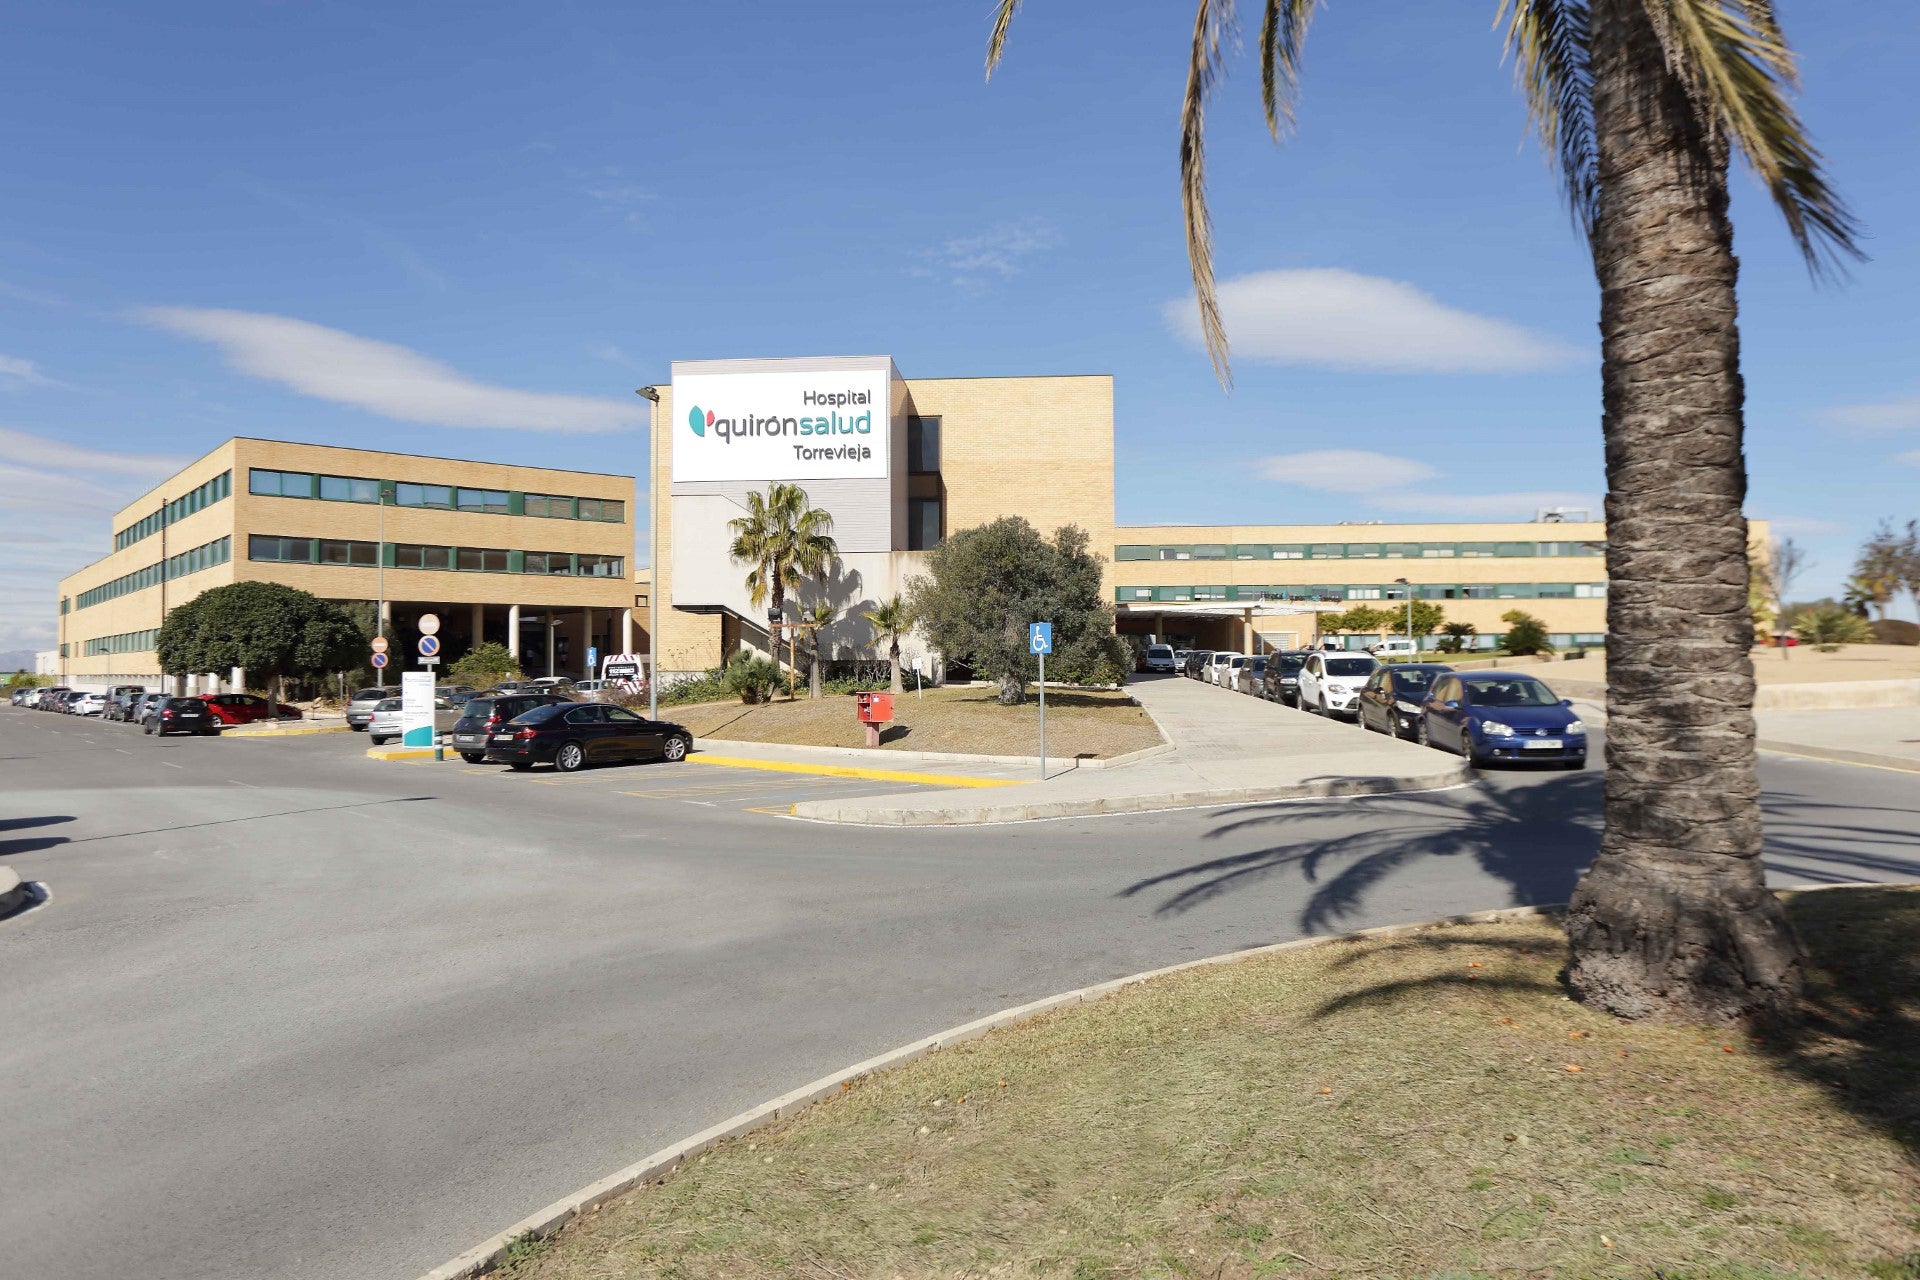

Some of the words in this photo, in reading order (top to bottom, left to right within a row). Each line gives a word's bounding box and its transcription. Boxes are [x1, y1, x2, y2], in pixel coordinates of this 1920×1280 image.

[803, 389, 871, 408] Hospital
[714, 409, 871, 445] quirónsalud
[793, 444, 871, 463] Torrevieja
